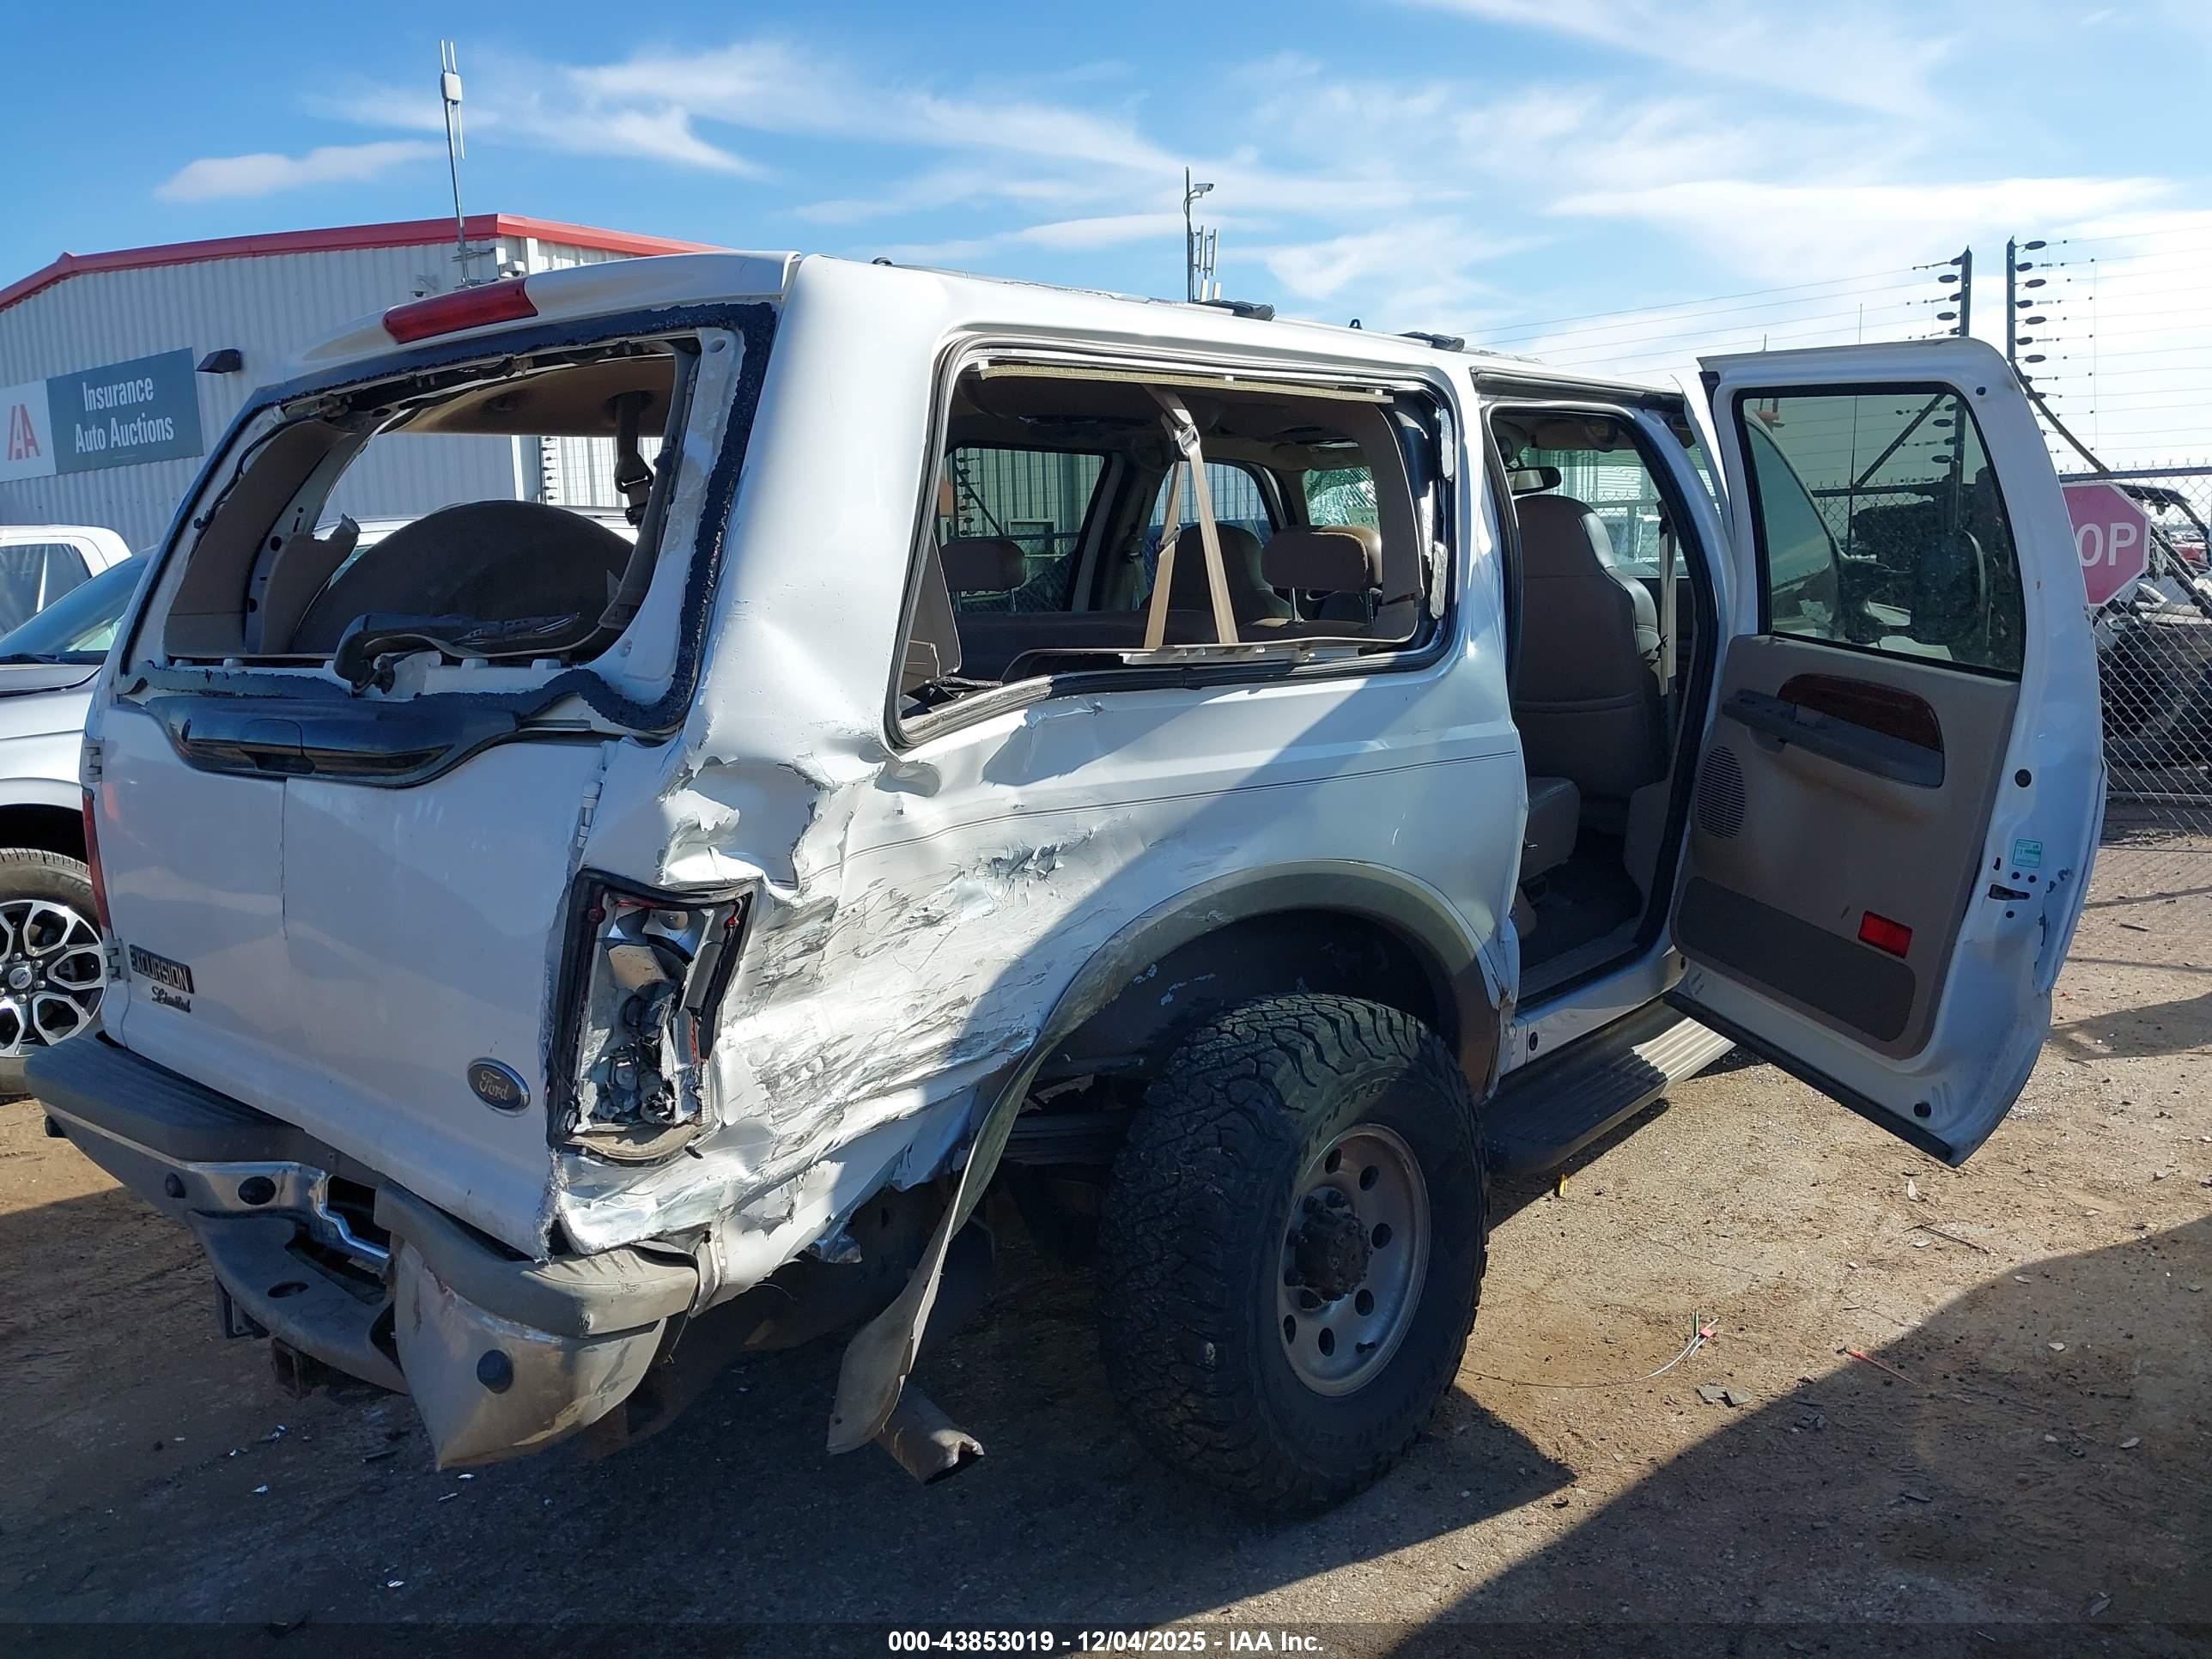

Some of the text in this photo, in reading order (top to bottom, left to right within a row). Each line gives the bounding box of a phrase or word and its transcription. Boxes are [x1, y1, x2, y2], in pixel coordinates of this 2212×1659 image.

[82, 378, 154, 411] Insurance
[75, 413, 174, 453] Auto Auctions
[2075, 521, 2137, 568] OP
[131, 948, 189, 992] EXCURSION
[151, 986, 191, 1014] Limited
[478, 1069, 509, 1101] Ford
